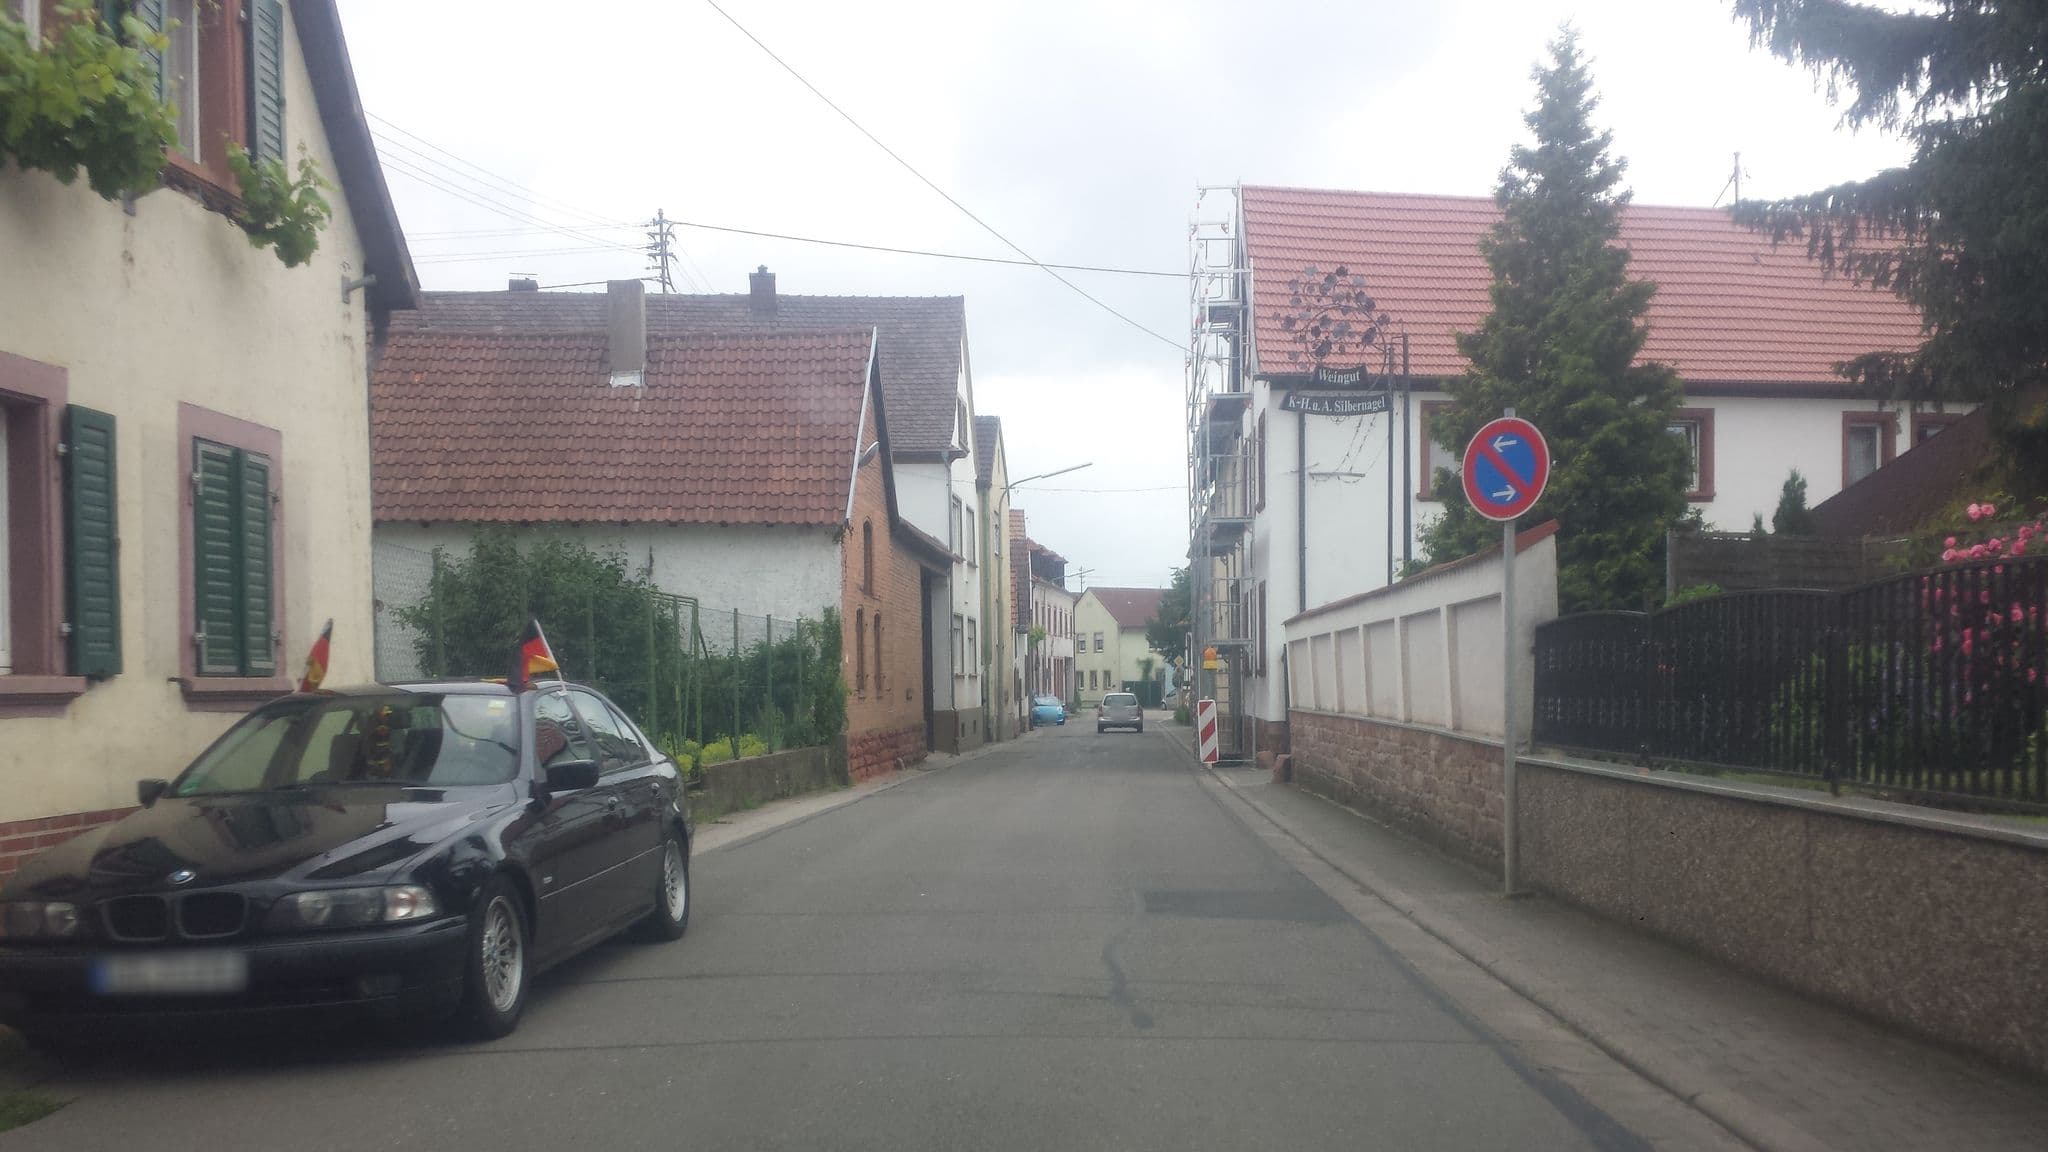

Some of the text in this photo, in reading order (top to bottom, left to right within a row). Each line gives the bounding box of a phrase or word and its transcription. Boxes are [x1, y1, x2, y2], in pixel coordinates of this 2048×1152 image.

[1318, 368, 1361, 384] Weingut
[1322, 401, 1332, 411] A.
[1334, 396, 1385, 413] Silbernagel
